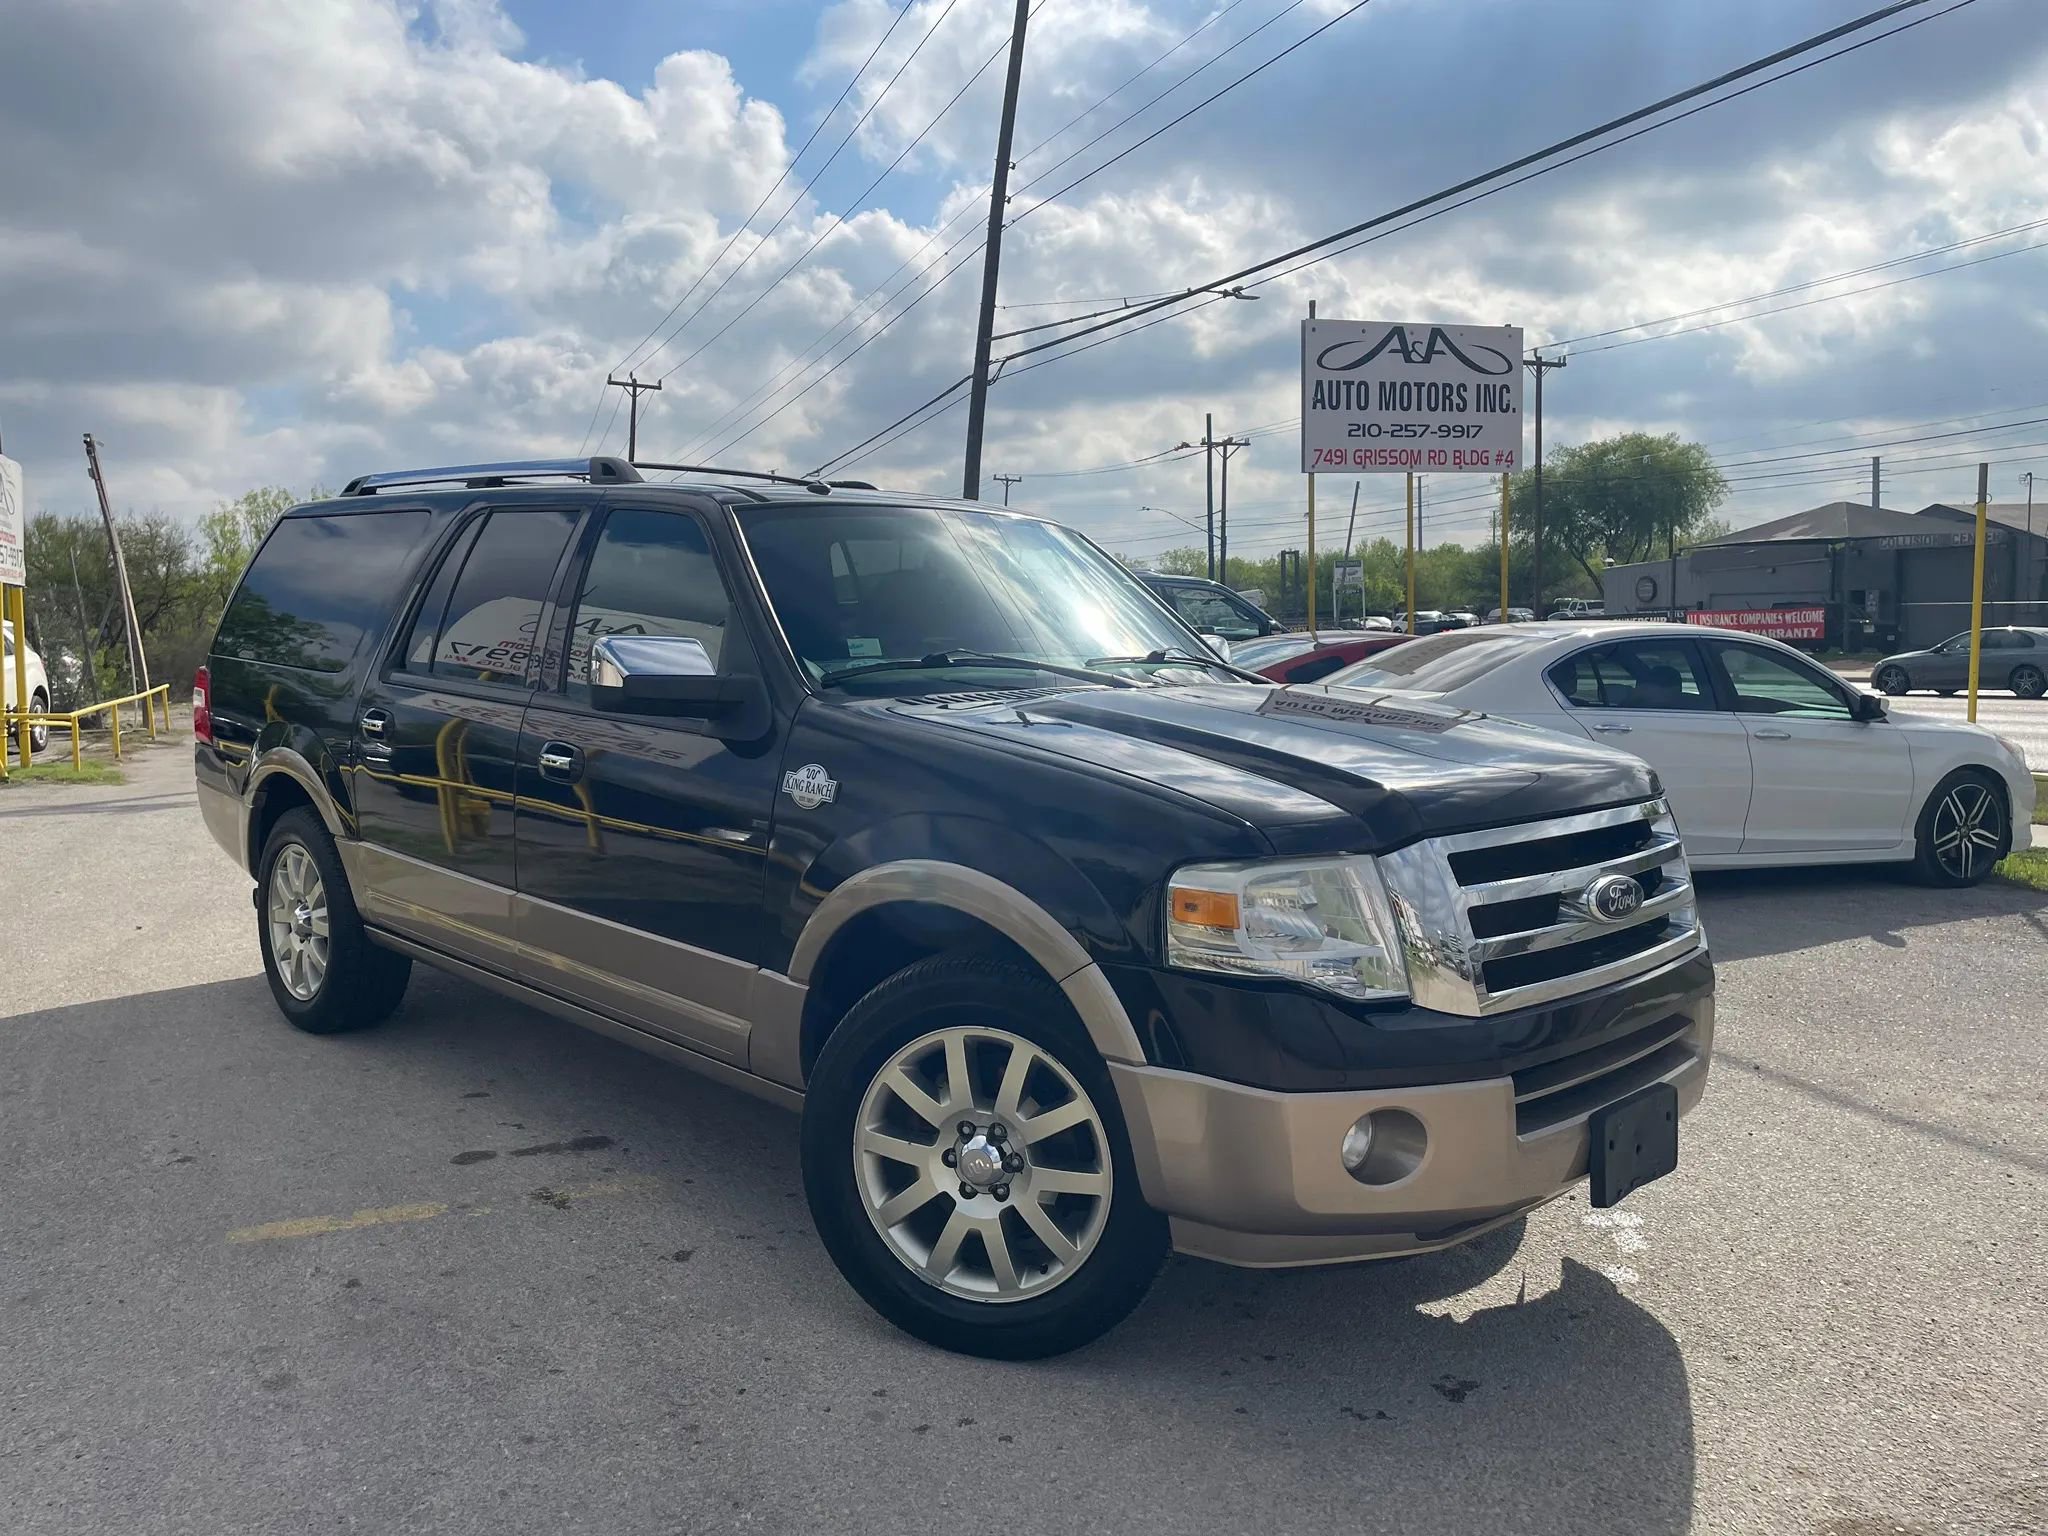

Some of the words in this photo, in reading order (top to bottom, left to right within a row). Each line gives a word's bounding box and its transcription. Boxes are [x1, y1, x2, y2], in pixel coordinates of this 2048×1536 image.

[1312, 379, 1370, 411] AUTO
[1378, 381, 1468, 413] MOTORS
[1475, 383, 1517, 414] INC.
[1347, 423, 1483, 439] 210-257-9917
[1313, 448, 1347, 466] 7491
[1353, 449, 1421, 466] GRISSOM
[1428, 449, 1447, 466] RD
[1453, 450, 1490, 466] BLDG
[1495, 450, 1514, 466] #4
[1952, 531, 2001, 546] CENE
[1686, 613, 1698, 625] ALL
[1699, 613, 1738, 626] INSURANCE
[1739, 612, 1783, 625] COMPANIES
[1785, 610, 1825, 624] WELCOME
[1749, 626, 1819, 639] WARRANTY
[785, 774, 805, 792] KING
[805, 781, 834, 798] RANCH
[1608, 883, 1637, 912] Ford
